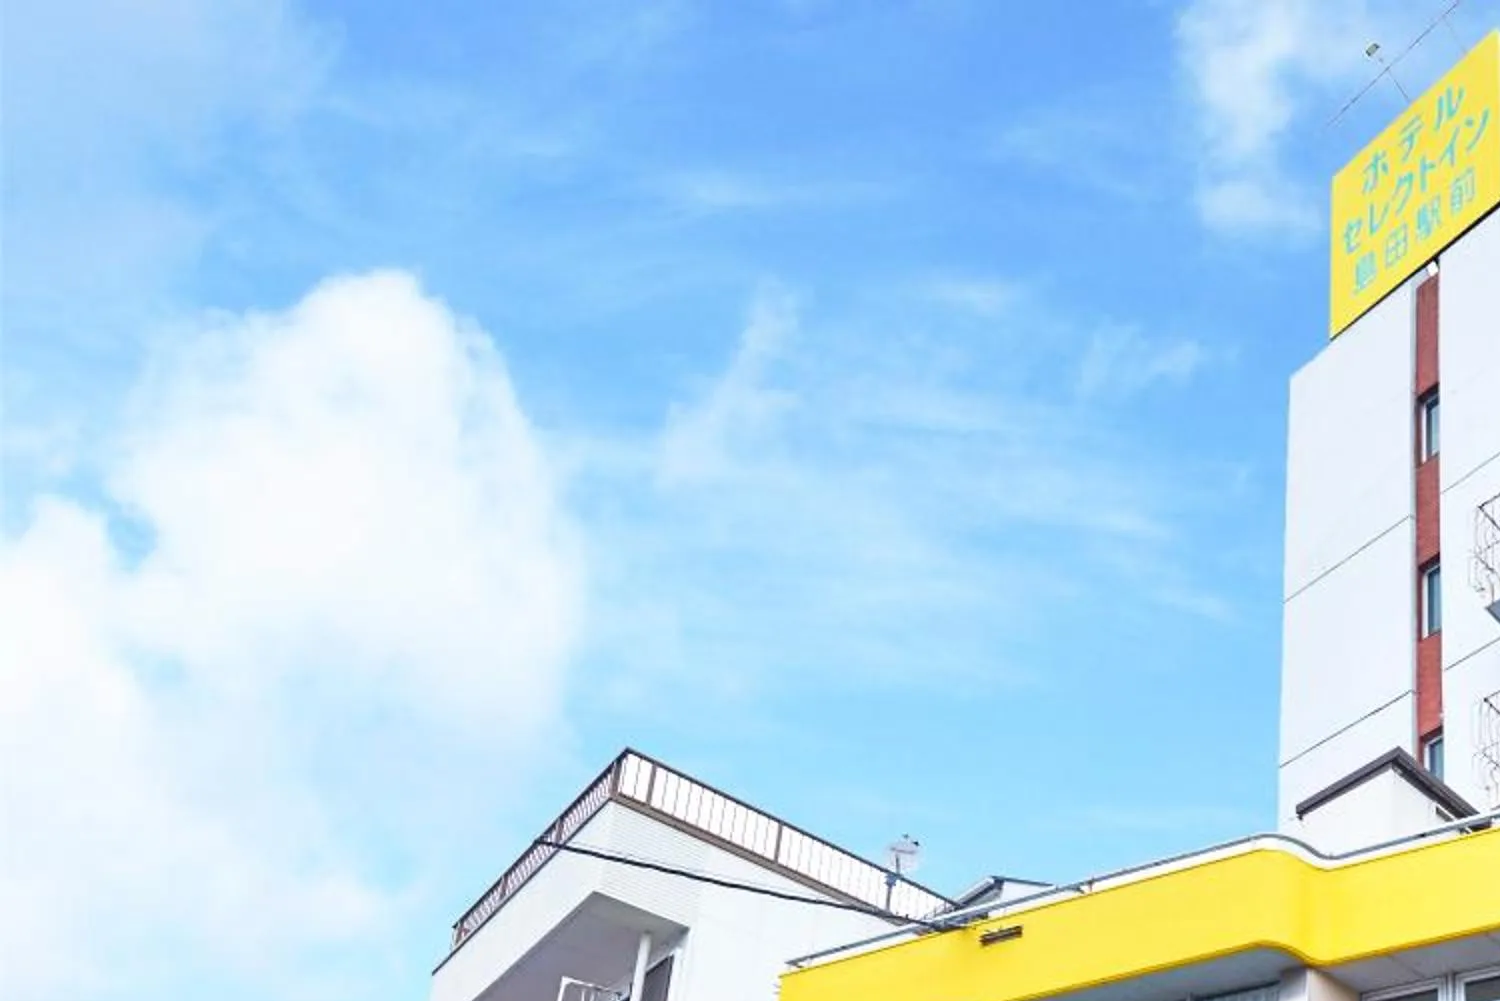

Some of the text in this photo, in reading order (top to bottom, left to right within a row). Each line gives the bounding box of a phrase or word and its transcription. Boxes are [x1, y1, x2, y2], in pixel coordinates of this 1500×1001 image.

[1344, 108, 1490, 254] セレクトイン
[1362, 86, 1465, 194] ホテル
